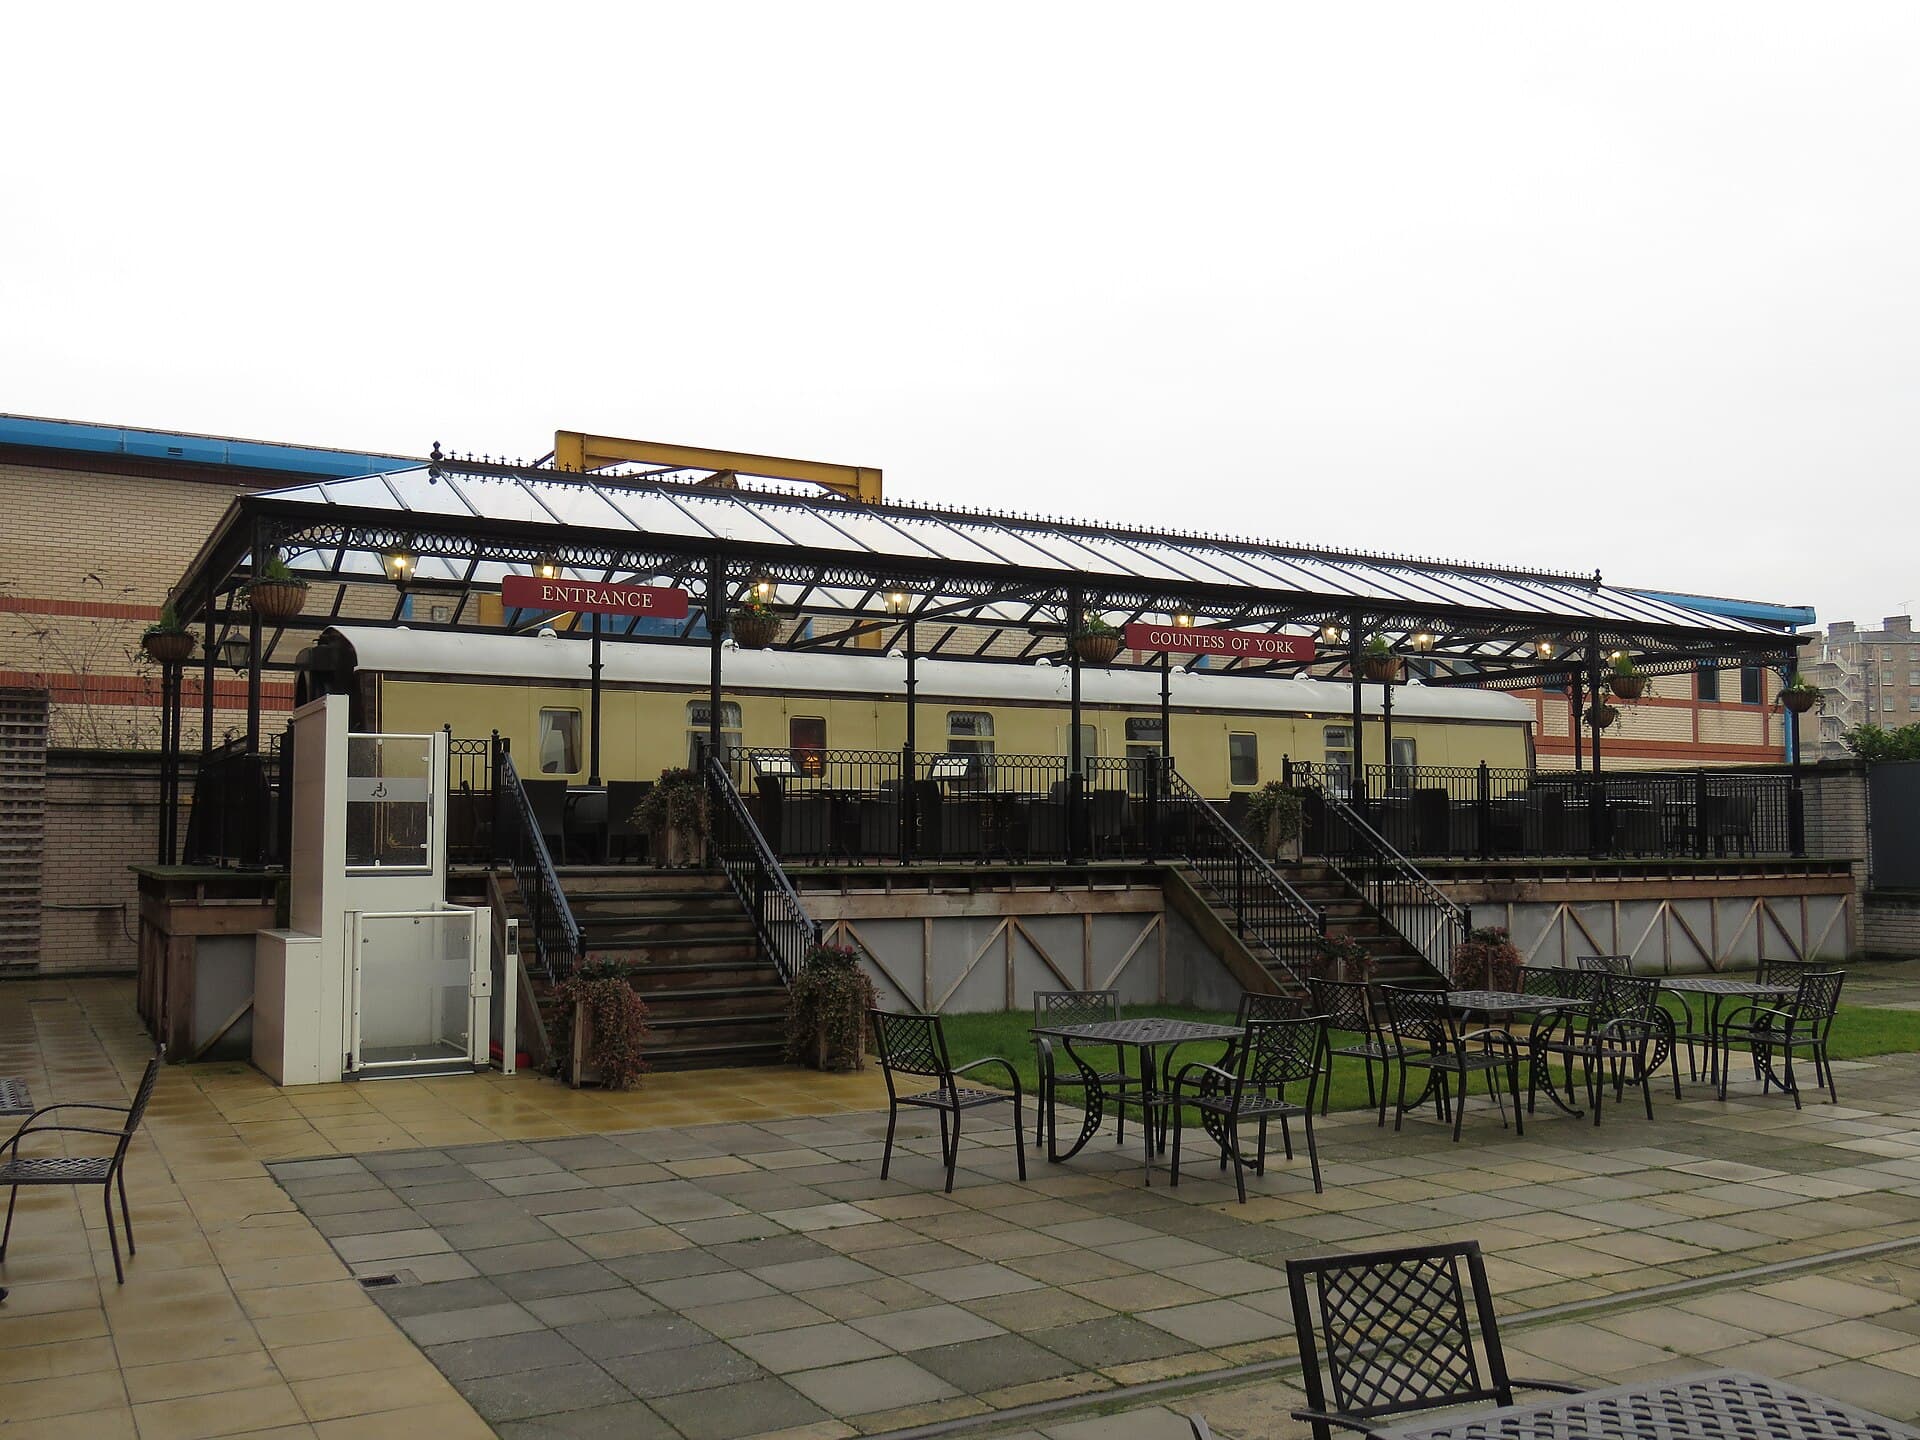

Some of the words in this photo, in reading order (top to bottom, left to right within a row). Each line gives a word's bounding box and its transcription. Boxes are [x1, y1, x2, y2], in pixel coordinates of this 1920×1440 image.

[542, 585, 653, 608] ENTRANCE
[1150, 631, 1225, 649] COUNTESS
[1231, 637, 1251, 650] OF
[1256, 640, 1294, 654] YORK
